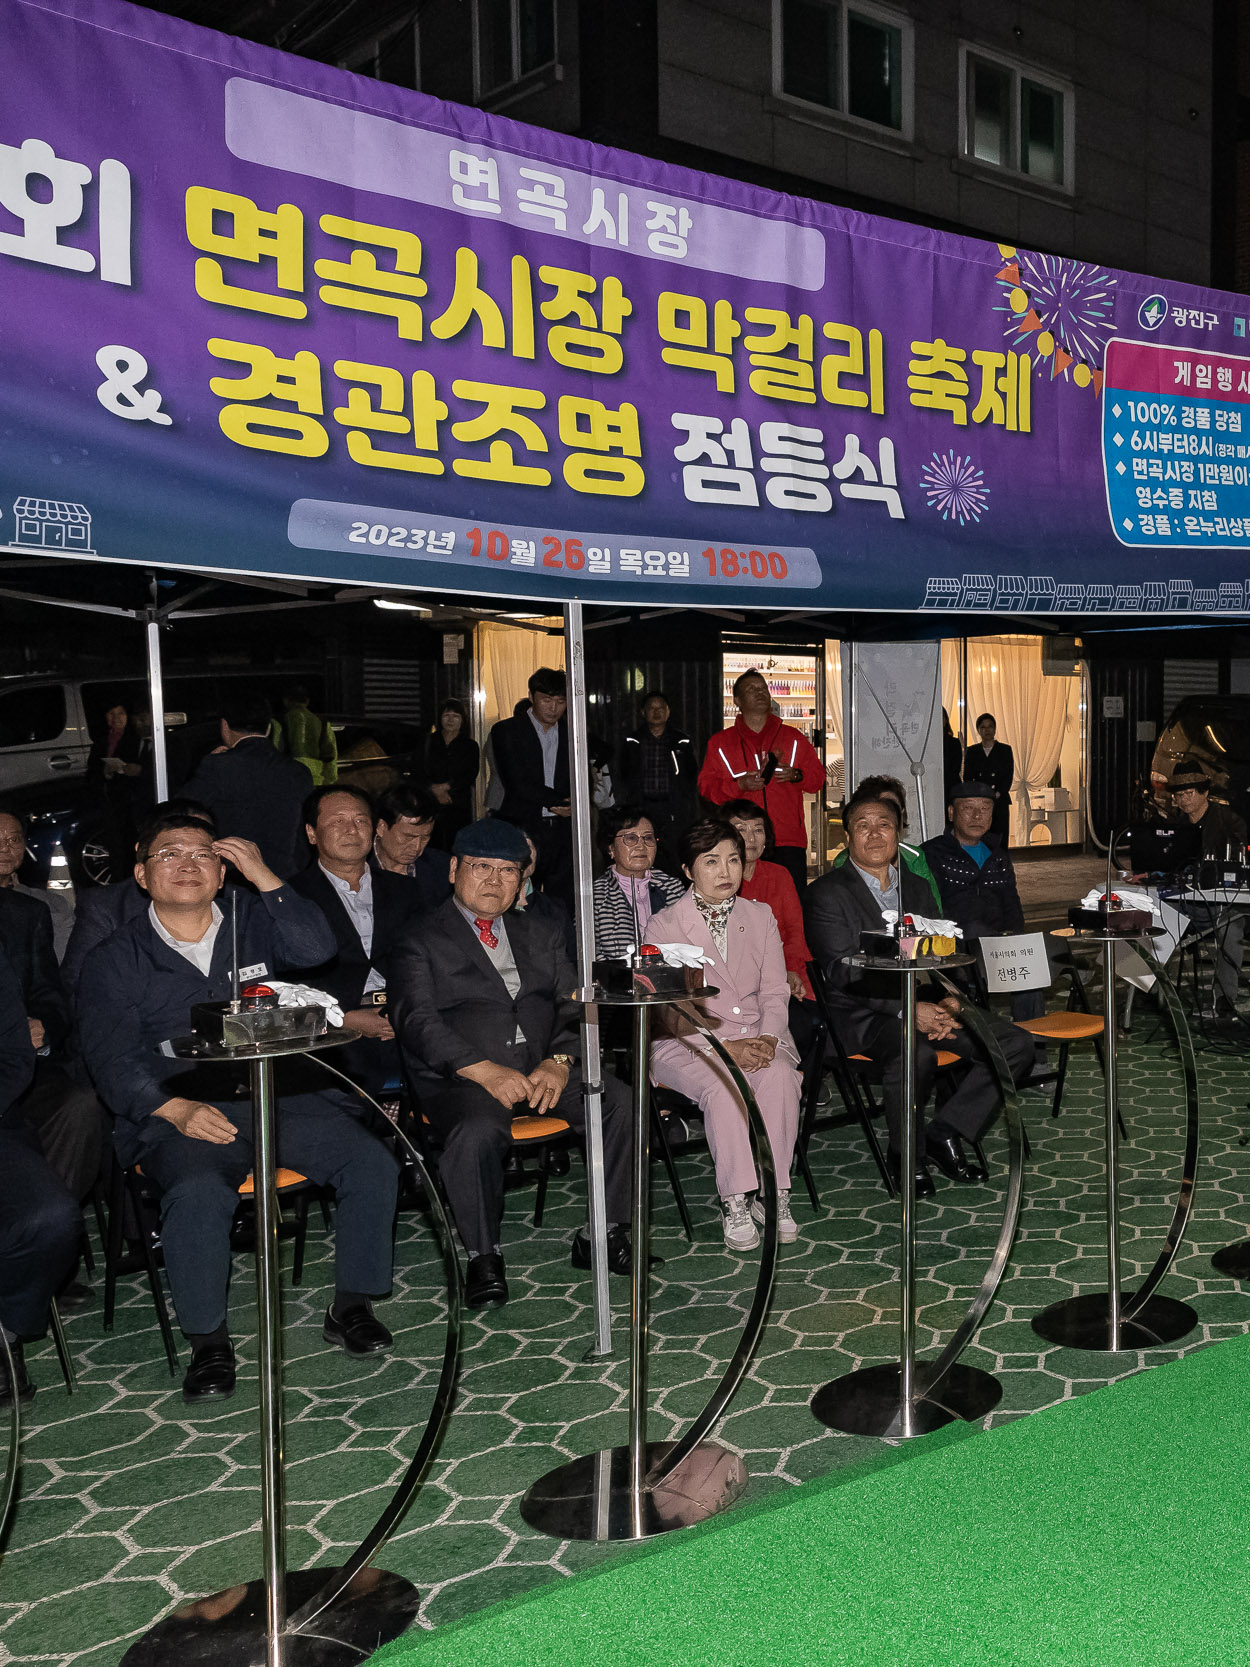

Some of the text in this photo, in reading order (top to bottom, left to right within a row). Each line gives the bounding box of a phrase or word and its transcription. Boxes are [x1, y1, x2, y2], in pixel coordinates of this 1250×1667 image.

[448, 149, 693, 259] 면곡시장
[0, 138, 1032, 434] 회 면곡시장 막걸리 축제
[1171, 307, 1219, 331] 광진구
[95, 337, 905, 520] & 경관조명 점등식
[1127, 401, 1242, 433] 100% 경품 당첨
[1130, 430, 1213, 457] 6시부터8시
[1132, 458, 1194, 483] 면곡시장
[1136, 486, 1218, 511] 영수증 지참
[1138, 514, 1172, 536] 경품
[348, 520, 789, 581] 2023년 10월 26일 목요일 18:00
[1020, 948, 1034, 956] 의원
[997, 967, 1031, 981] 전병주
